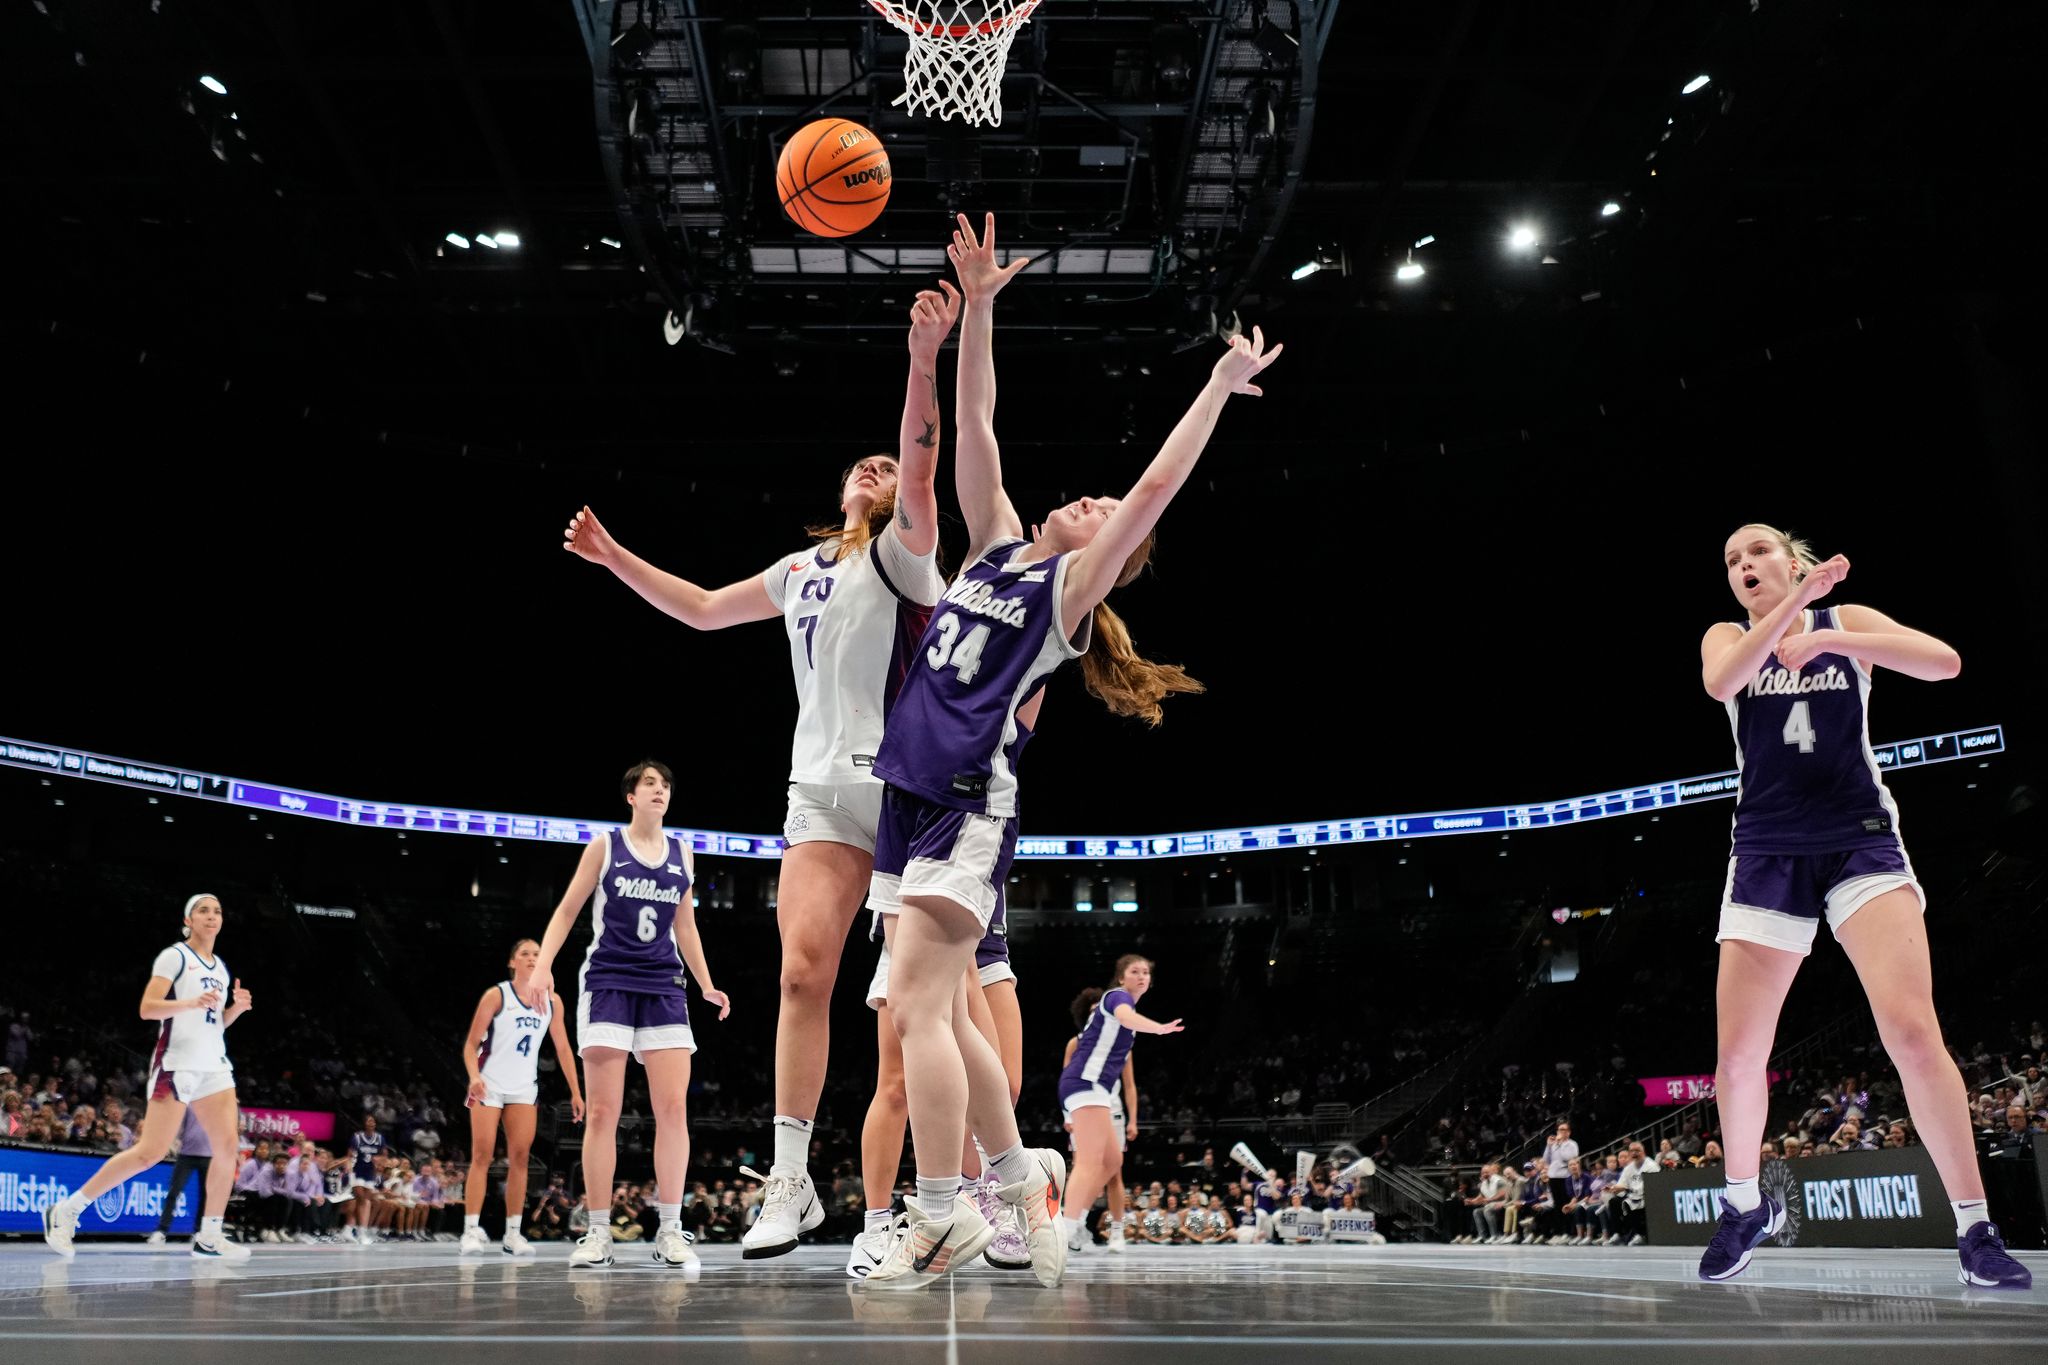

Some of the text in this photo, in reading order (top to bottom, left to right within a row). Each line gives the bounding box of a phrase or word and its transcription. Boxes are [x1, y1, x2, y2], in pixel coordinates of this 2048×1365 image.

[843, 159, 892, 188] ilson
[801, 577, 834, 602] CU
[942, 574, 1027, 629] Wildcats
[797, 615, 818, 670] 7
[927, 611, 991, 685] 34
[1747, 664, 1849, 699] Wildcats
[1783, 700, 1816, 754] 4
[1963, 734, 1997, 748] NCAAW
[8, 745, 60, 767] University
[126, 766, 177, 788] University
[1680, 780, 1723, 797] American
[1085, 841, 1107, 856] 55
[615, 876, 681, 905] Wildcats
[637, 905, 658, 943] 6
[200, 977, 223, 992] TCU
[516, 1016, 540, 1030] TCU
[516, 1034, 532, 1057] 4
[126, 1181, 188, 1217] Allste
[1674, 1189, 1709, 1224] FIRST
[1804, 1174, 1921, 1220] FIRST WATCH
[1330, 1219, 1374, 1233] DEFENSE
